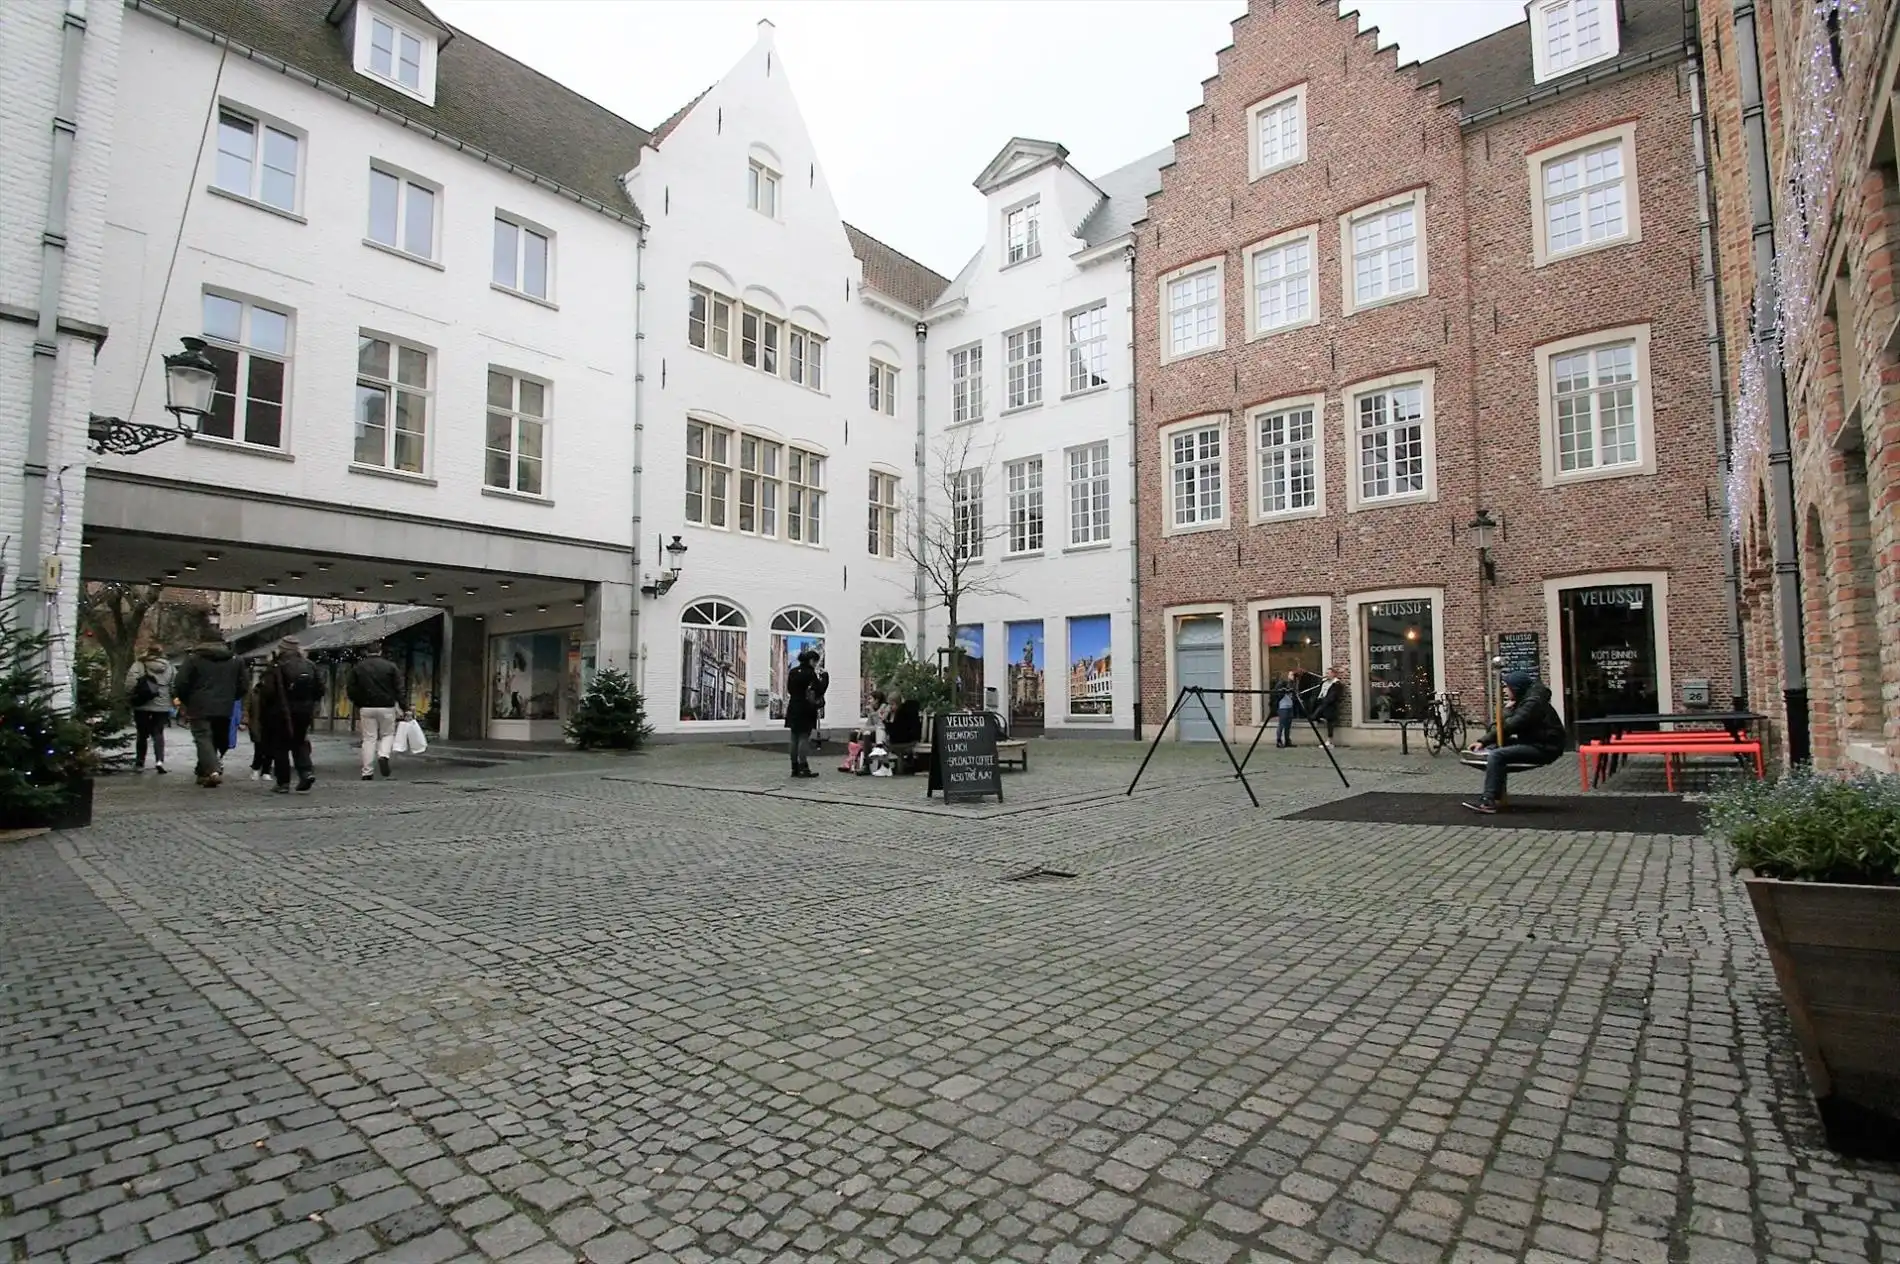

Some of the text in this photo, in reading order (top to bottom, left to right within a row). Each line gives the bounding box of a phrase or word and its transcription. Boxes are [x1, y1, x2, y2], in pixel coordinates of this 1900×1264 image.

[1580, 588, 1644, 606] VELUSSO
[1504, 633, 1532, 641] VELUSSO
[1370, 644, 1404, 653] COFFEE
[1370, 663, 1391, 671] RIDE
[1688, 692, 1703, 701] 26
[946, 715, 985, 727] VELUSSO
[947, 743, 968, 752] LUNCH
[975, 755, 994, 766] COFFEE
[950, 771, 964, 782] ALSO
